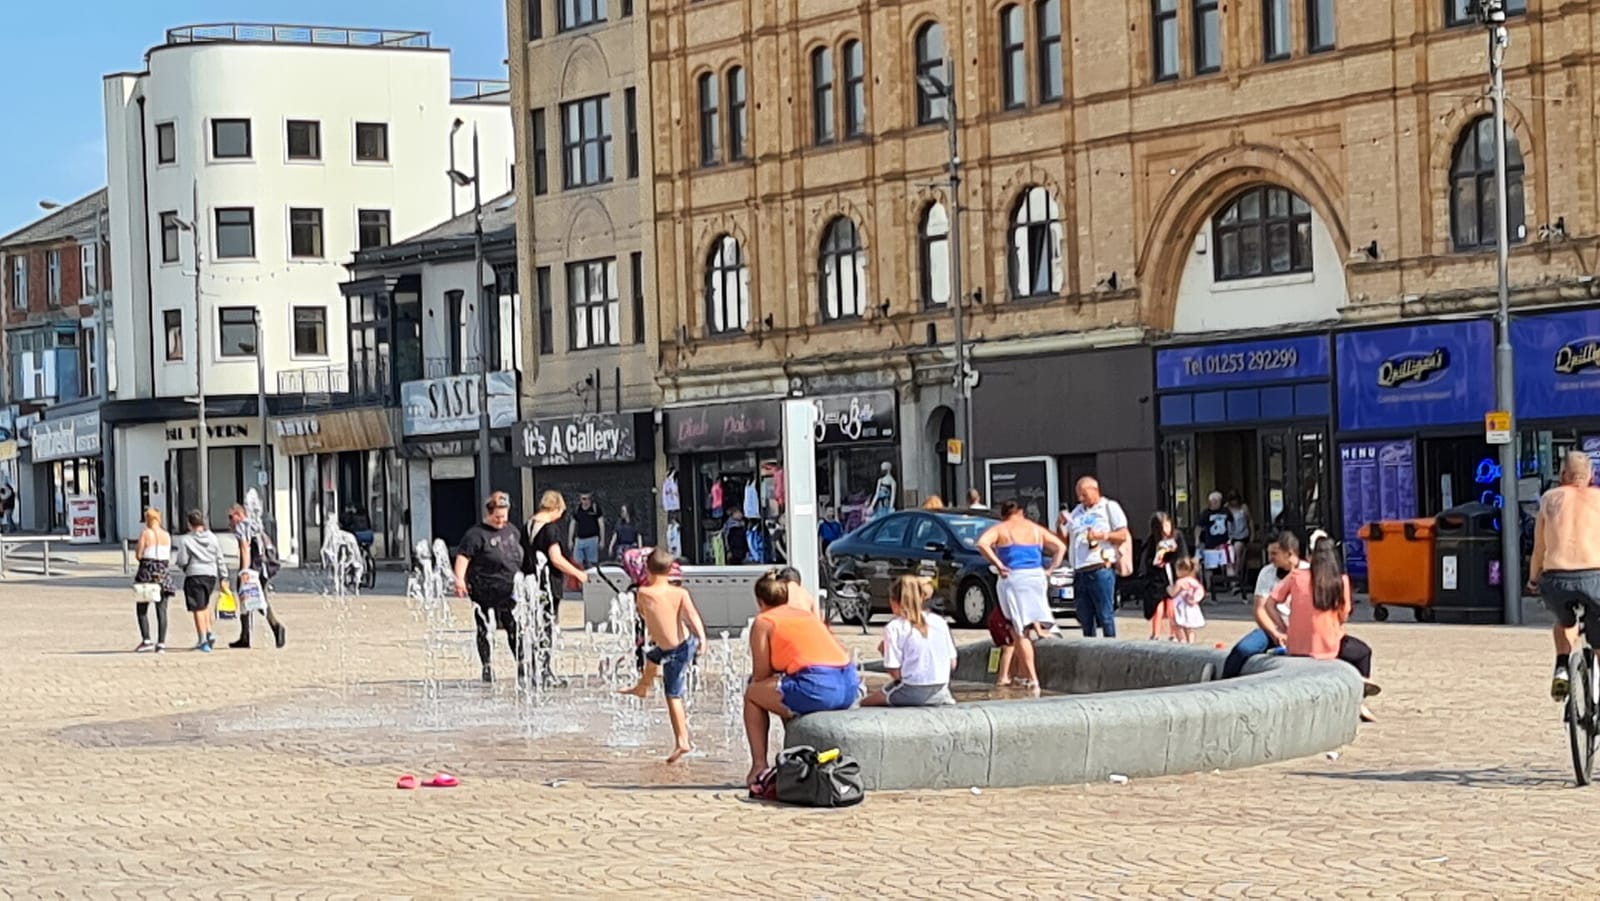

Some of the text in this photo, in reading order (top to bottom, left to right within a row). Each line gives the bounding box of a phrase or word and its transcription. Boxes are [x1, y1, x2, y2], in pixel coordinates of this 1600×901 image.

[1183, 347, 1297, 376] Tel 01253 292299
[189, 423, 249, 440] TVERN
[523, 423, 619, 457] It's A Gallery
[1341, 447, 1377, 459] MENU
